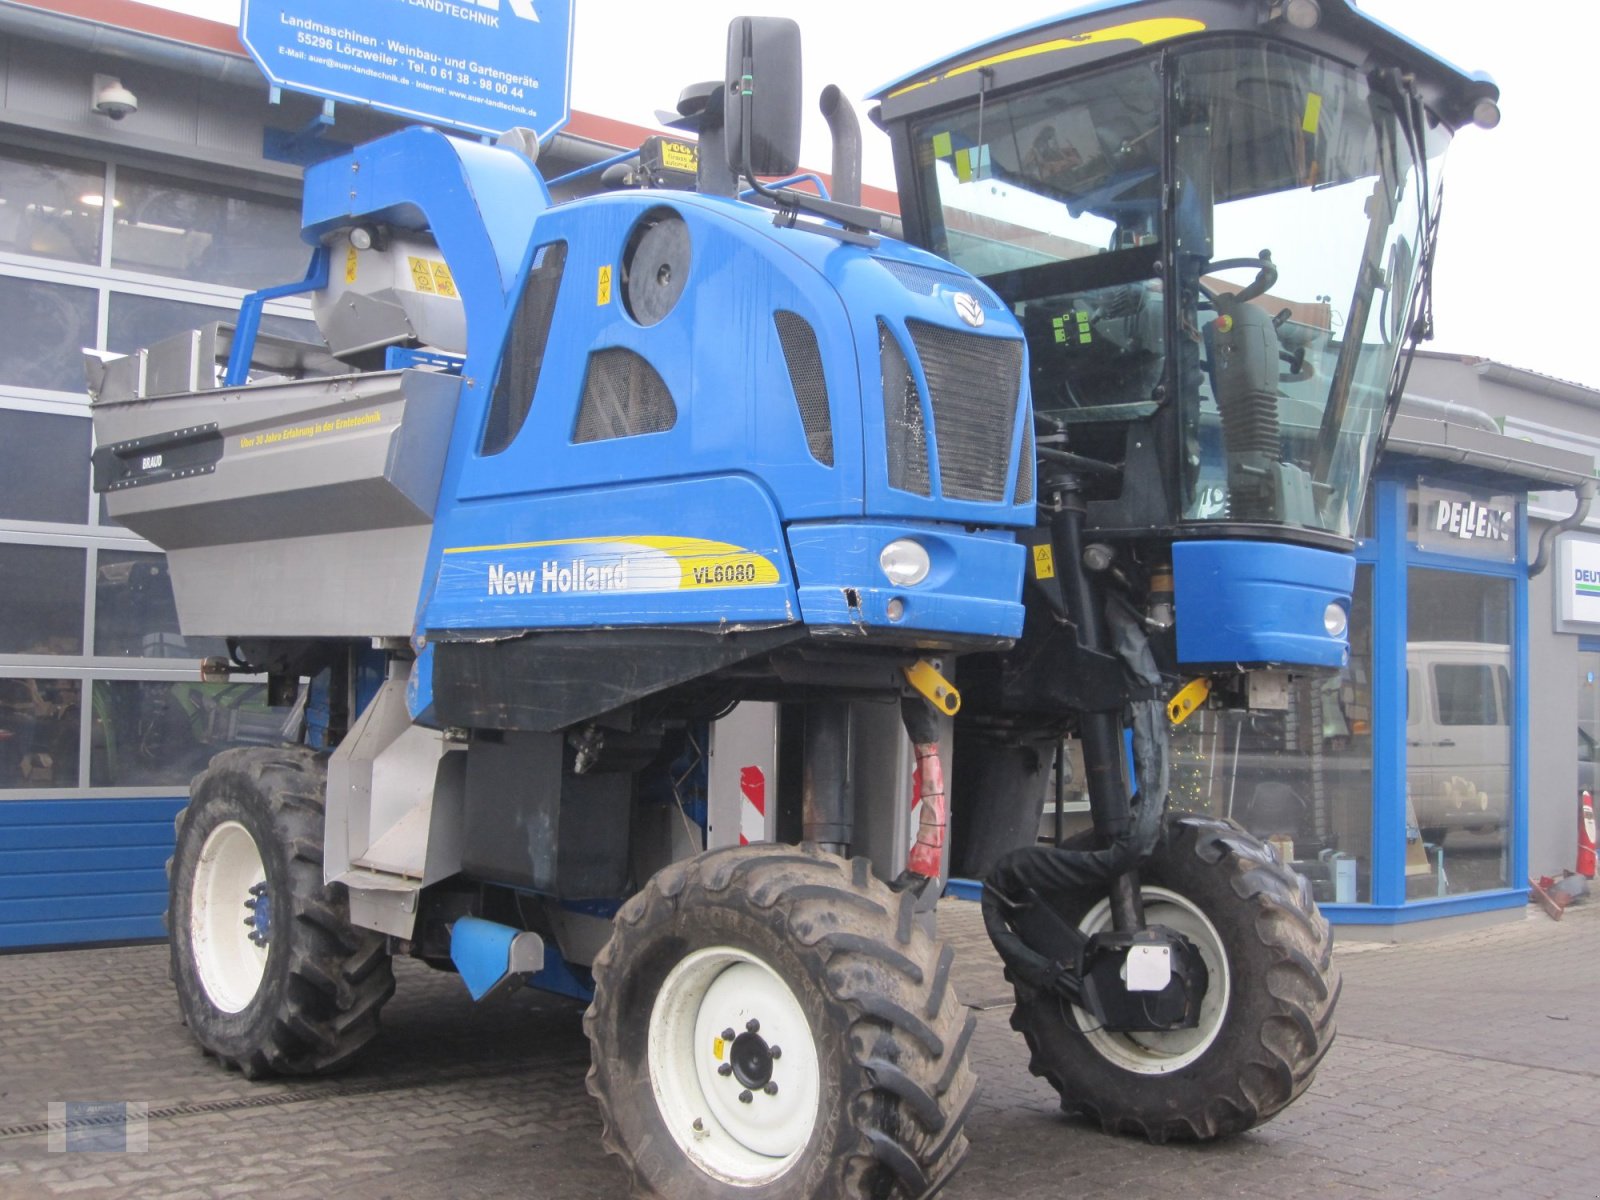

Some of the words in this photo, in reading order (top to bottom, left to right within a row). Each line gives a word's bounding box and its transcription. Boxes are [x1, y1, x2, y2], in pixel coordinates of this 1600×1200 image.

[281, 13, 377, 47] Landmaschinen
[388, 40, 441, 62] Weinbau-
[445, 57, 466, 69] und
[469, 62, 539, 88] Gartengeräte
[297, 32, 333, 50] 55296
[336, 42, 398, 66] Lörzweiler
[408, 60, 427, 75] Tel.
[430, 66, 437, 76] 0
[440, 68, 453, 80] 61
[456, 73, 469, 85] 38
[480, 79, 492, 90] 98
[495, 83, 507, 94] 00
[510, 87, 523, 98] 44
[279, 46, 306, 60] E-Mail:
[308, 55, 410, 85] auer@auer-landtechnik.de
[416, 80, 446, 94] Internet:
[448, 89, 537, 117] www.auer-landtechnik.de
[283, 424, 314, 439] Erfahrung
[336, 410, 382, 429] Erntetechnik
[142, 455, 162, 469] BRAUD
[487, 564, 536, 595] New
[541, 556, 628, 593] Holland
[693, 563, 755, 584] VL6080
